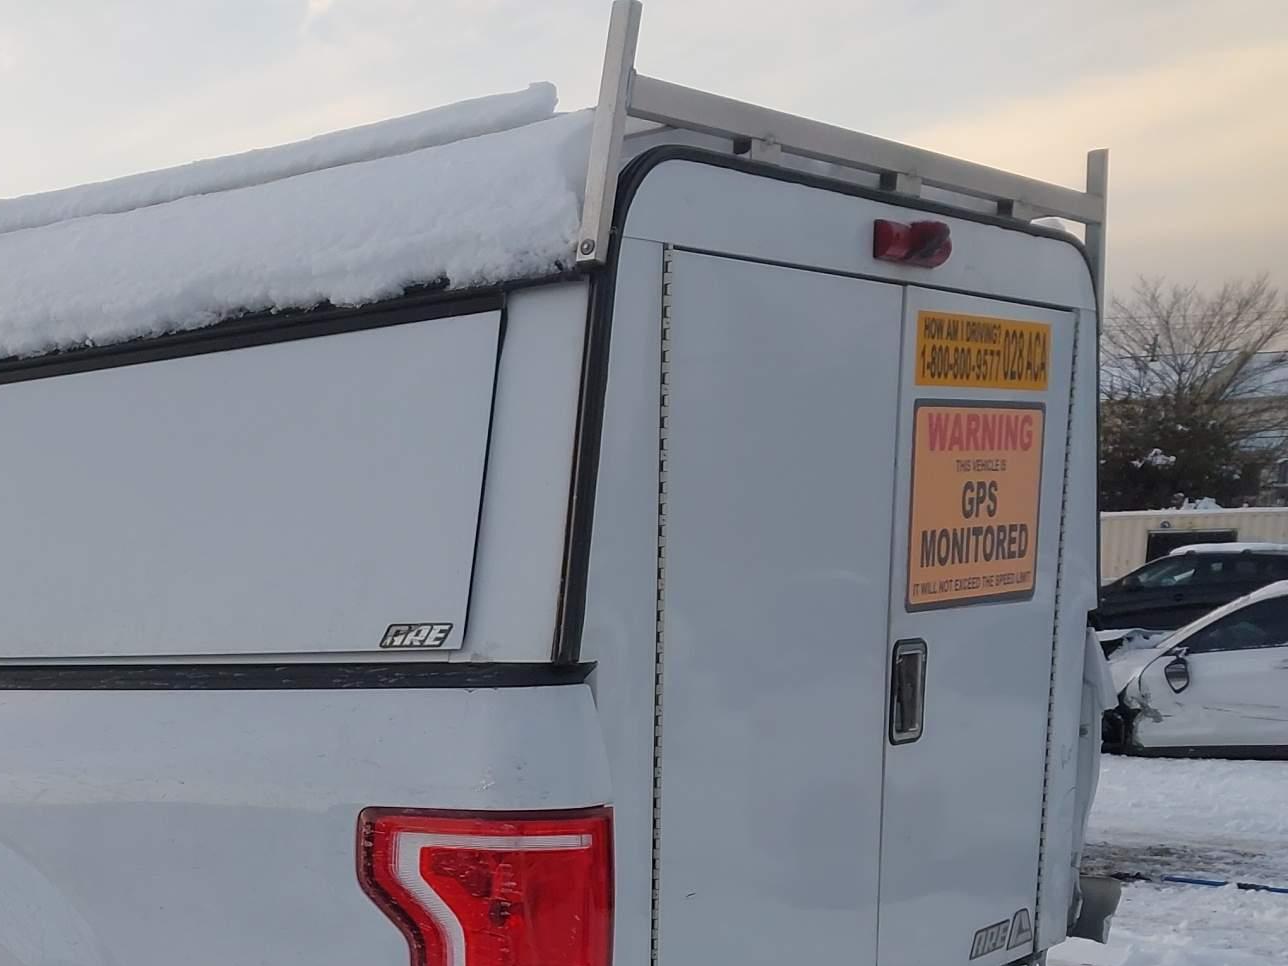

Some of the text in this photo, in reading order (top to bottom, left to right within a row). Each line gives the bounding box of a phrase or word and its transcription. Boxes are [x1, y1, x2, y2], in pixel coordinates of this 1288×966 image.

[924, 317, 944, 340] HOW
[946, 319, 959, 341] AM
[966, 320, 1002, 344] DRIVING?
[920, 344, 1002, 382] 1-800-800-9577
[1003, 329, 1048, 382] 028 ACA
[928, 412, 1033, 451] WARNING
[956, 459, 1007, 472] THIS VEHICLE IS
[962, 480, 998, 519] GPS
[920, 523, 1029, 568] MONITORED
[912, 571, 1032, 597] IT WILL NOT EXCEED THE SPEED LIMIT
[381, 624, 453, 647] ARE
